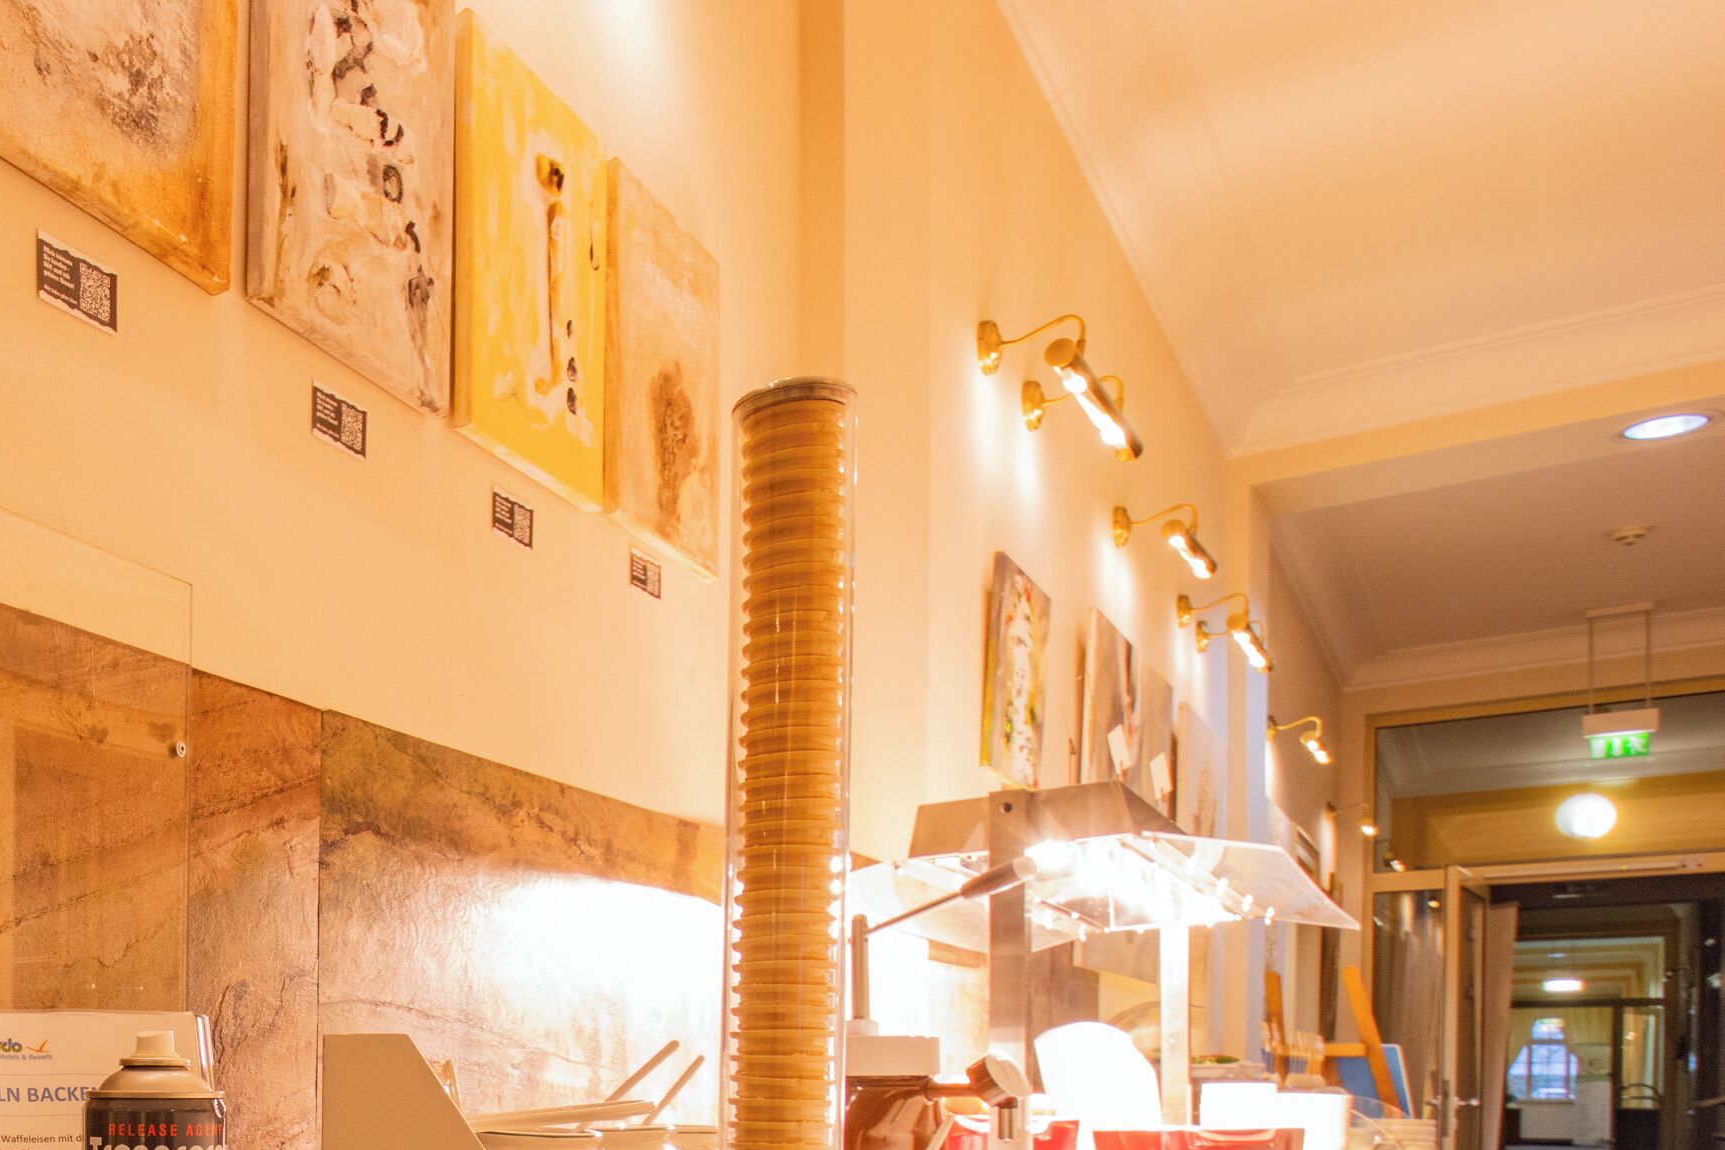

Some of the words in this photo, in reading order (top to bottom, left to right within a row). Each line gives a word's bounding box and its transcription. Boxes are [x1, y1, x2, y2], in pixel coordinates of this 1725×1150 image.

[27, 1086, 97, 1102] BACKE
[108, 1122, 178, 1137] RELEASE
[186, 1123, 223, 1137] AGENT
[0, 1134, 56, 1144] Waffeleisen
[58, 1134, 74, 1143] mit
[75, 1134, 83, 1142] d
